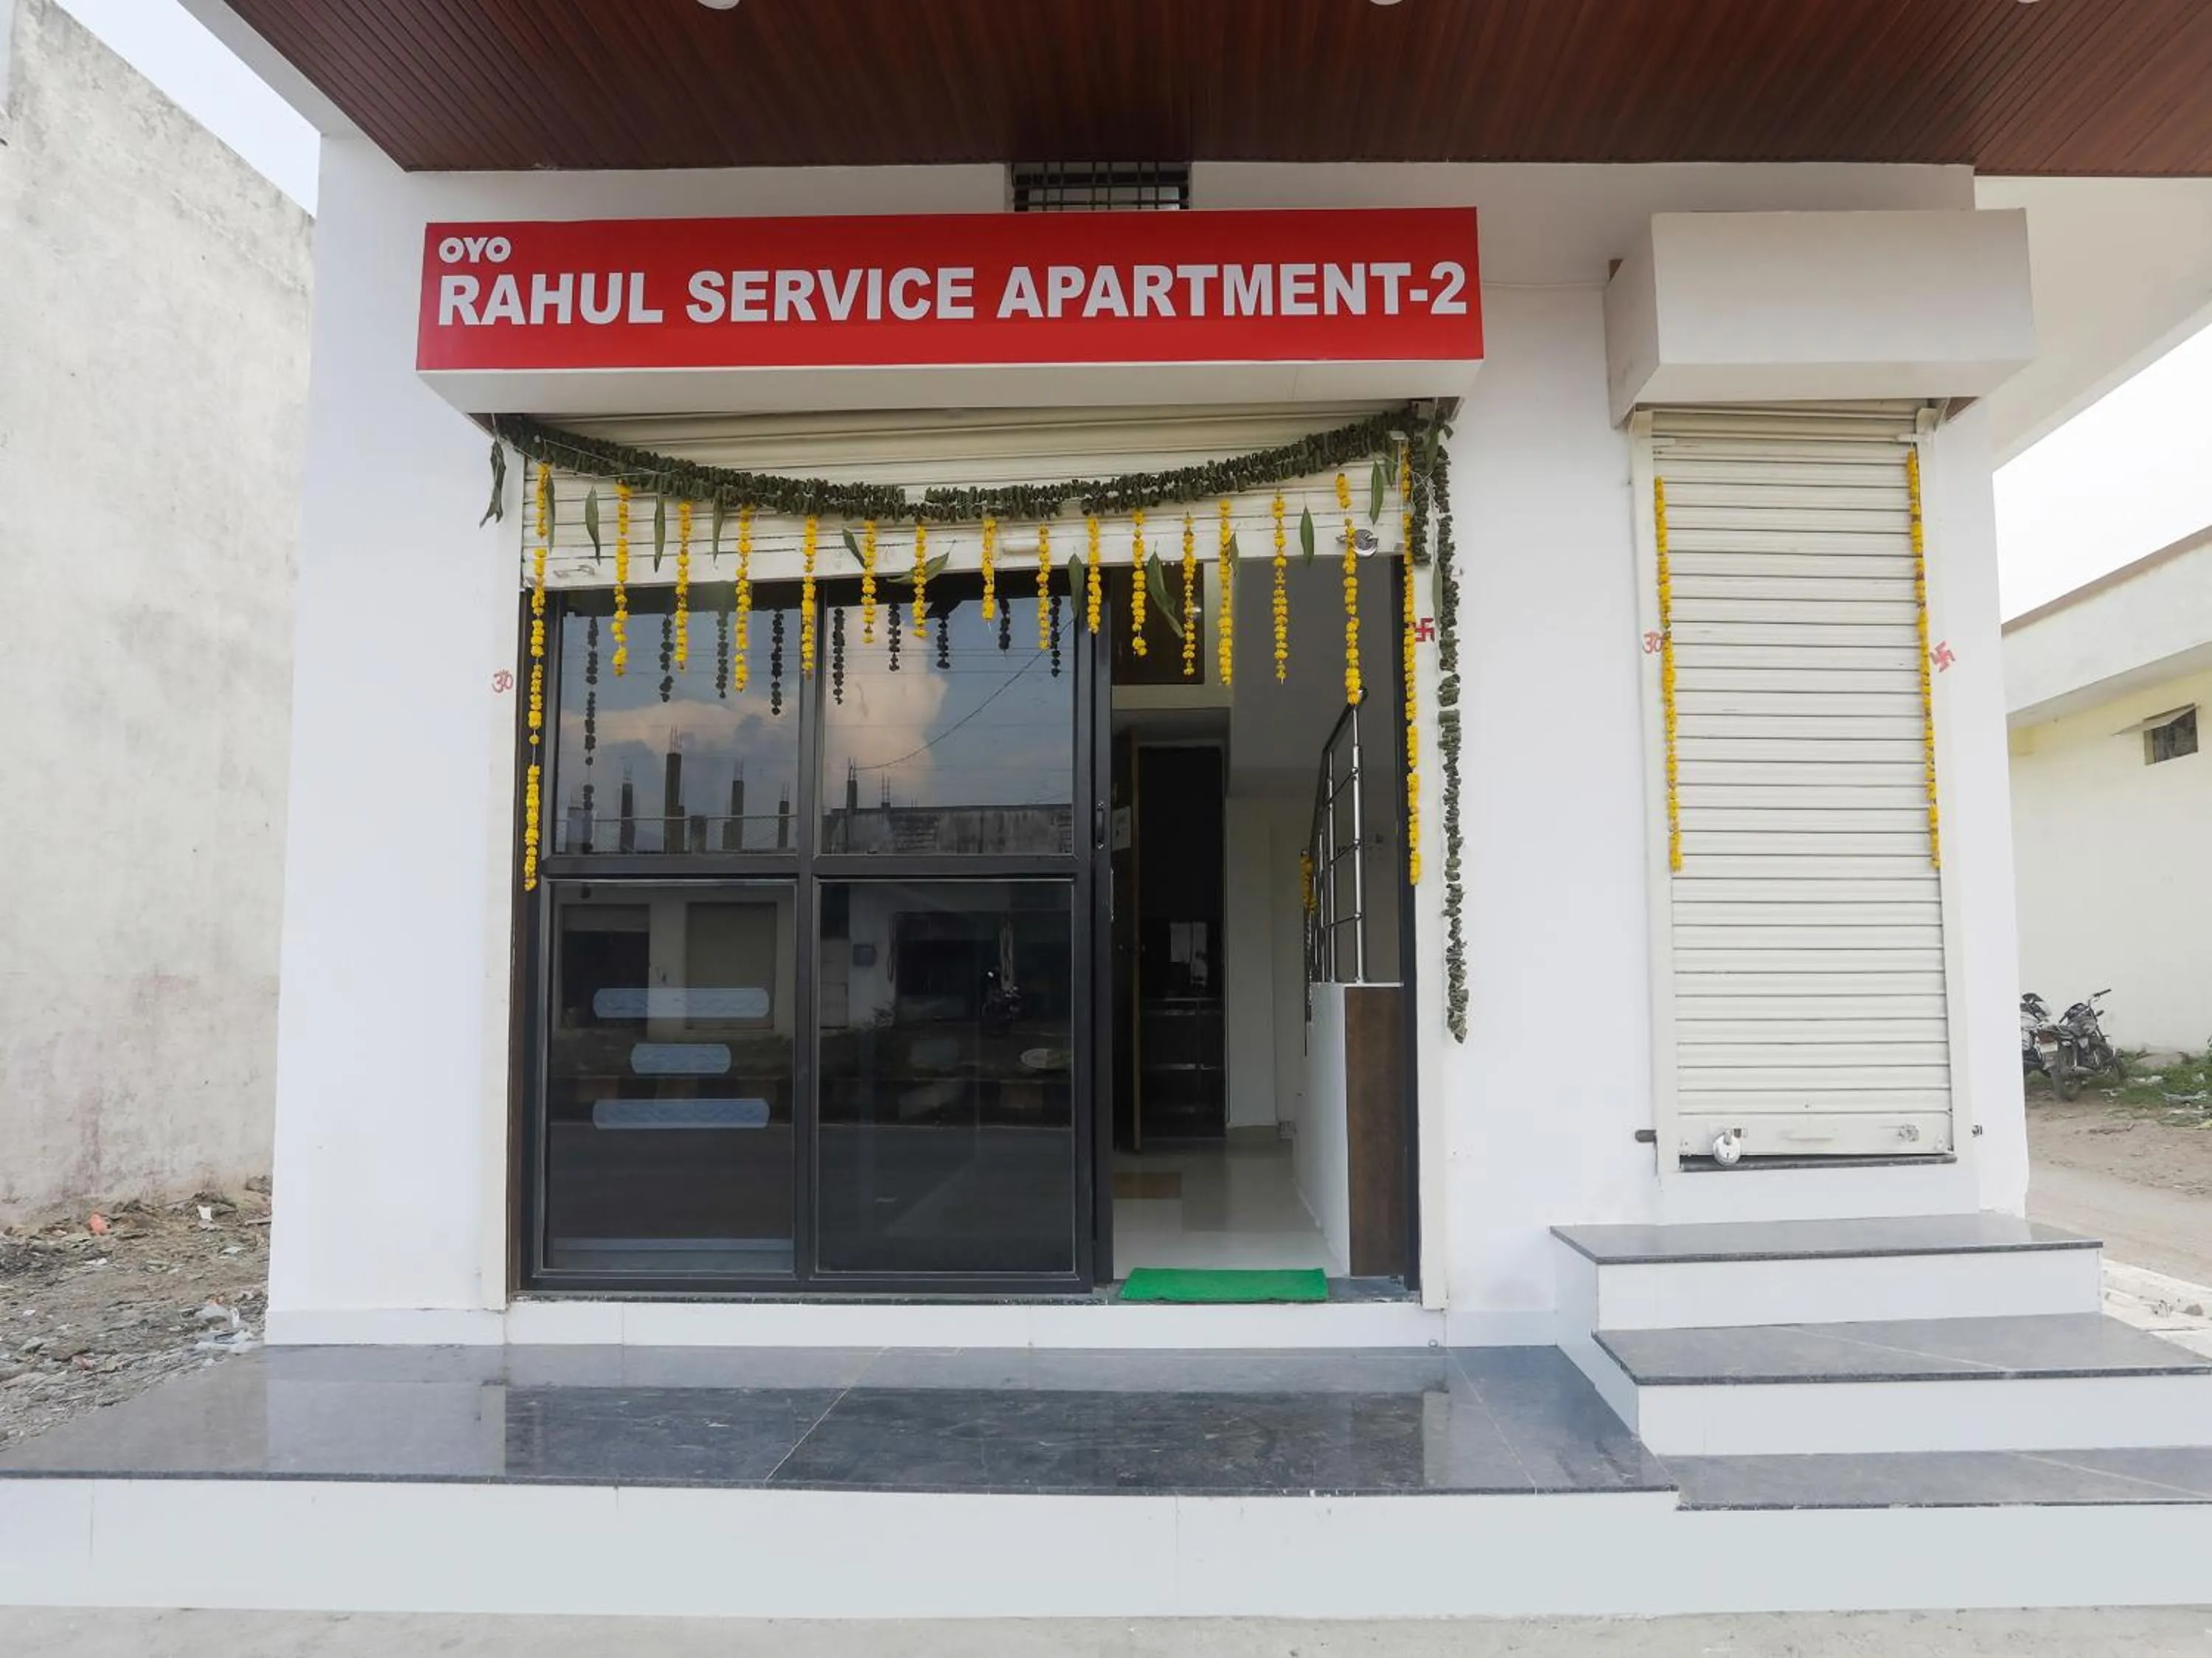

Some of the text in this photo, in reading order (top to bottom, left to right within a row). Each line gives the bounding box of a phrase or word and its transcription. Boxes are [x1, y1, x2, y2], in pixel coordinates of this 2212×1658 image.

[438, 237, 512, 264] OYO
[438, 262, 1467, 326] RAHUL SERVICE APARTMENT-2
